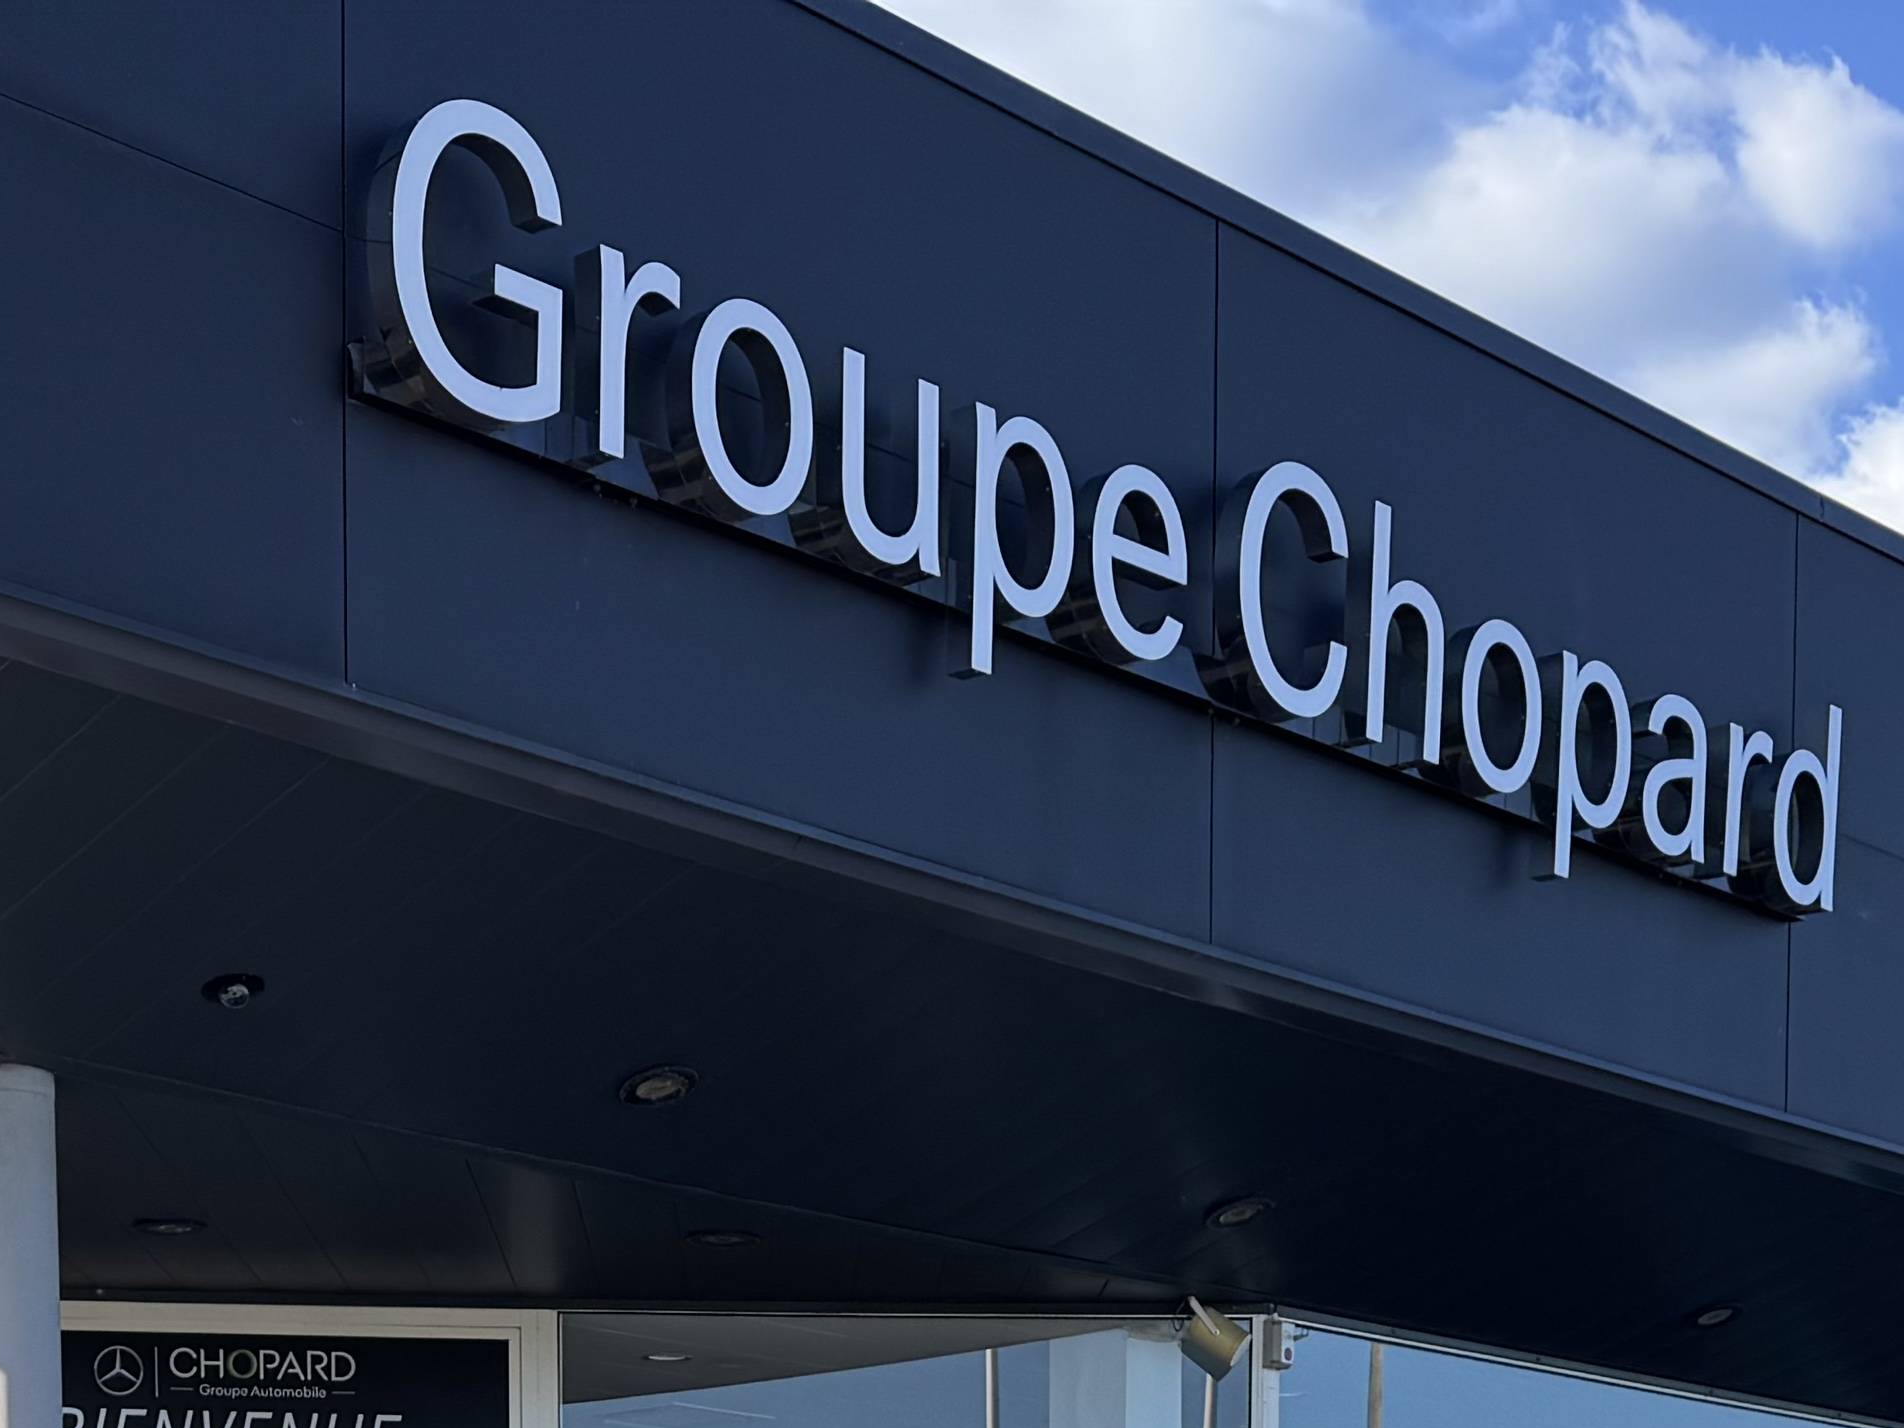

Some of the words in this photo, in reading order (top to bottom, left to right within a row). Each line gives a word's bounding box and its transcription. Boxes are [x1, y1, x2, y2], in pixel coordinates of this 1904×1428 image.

[390, 98, 1188, 676] Groupe
[1239, 459, 1844, 914] Chopard
[169, 1347, 356, 1382] CHOPARD
[199, 1384, 248, 1399] Groupe
[251, 1384, 327, 1400] Automobile
